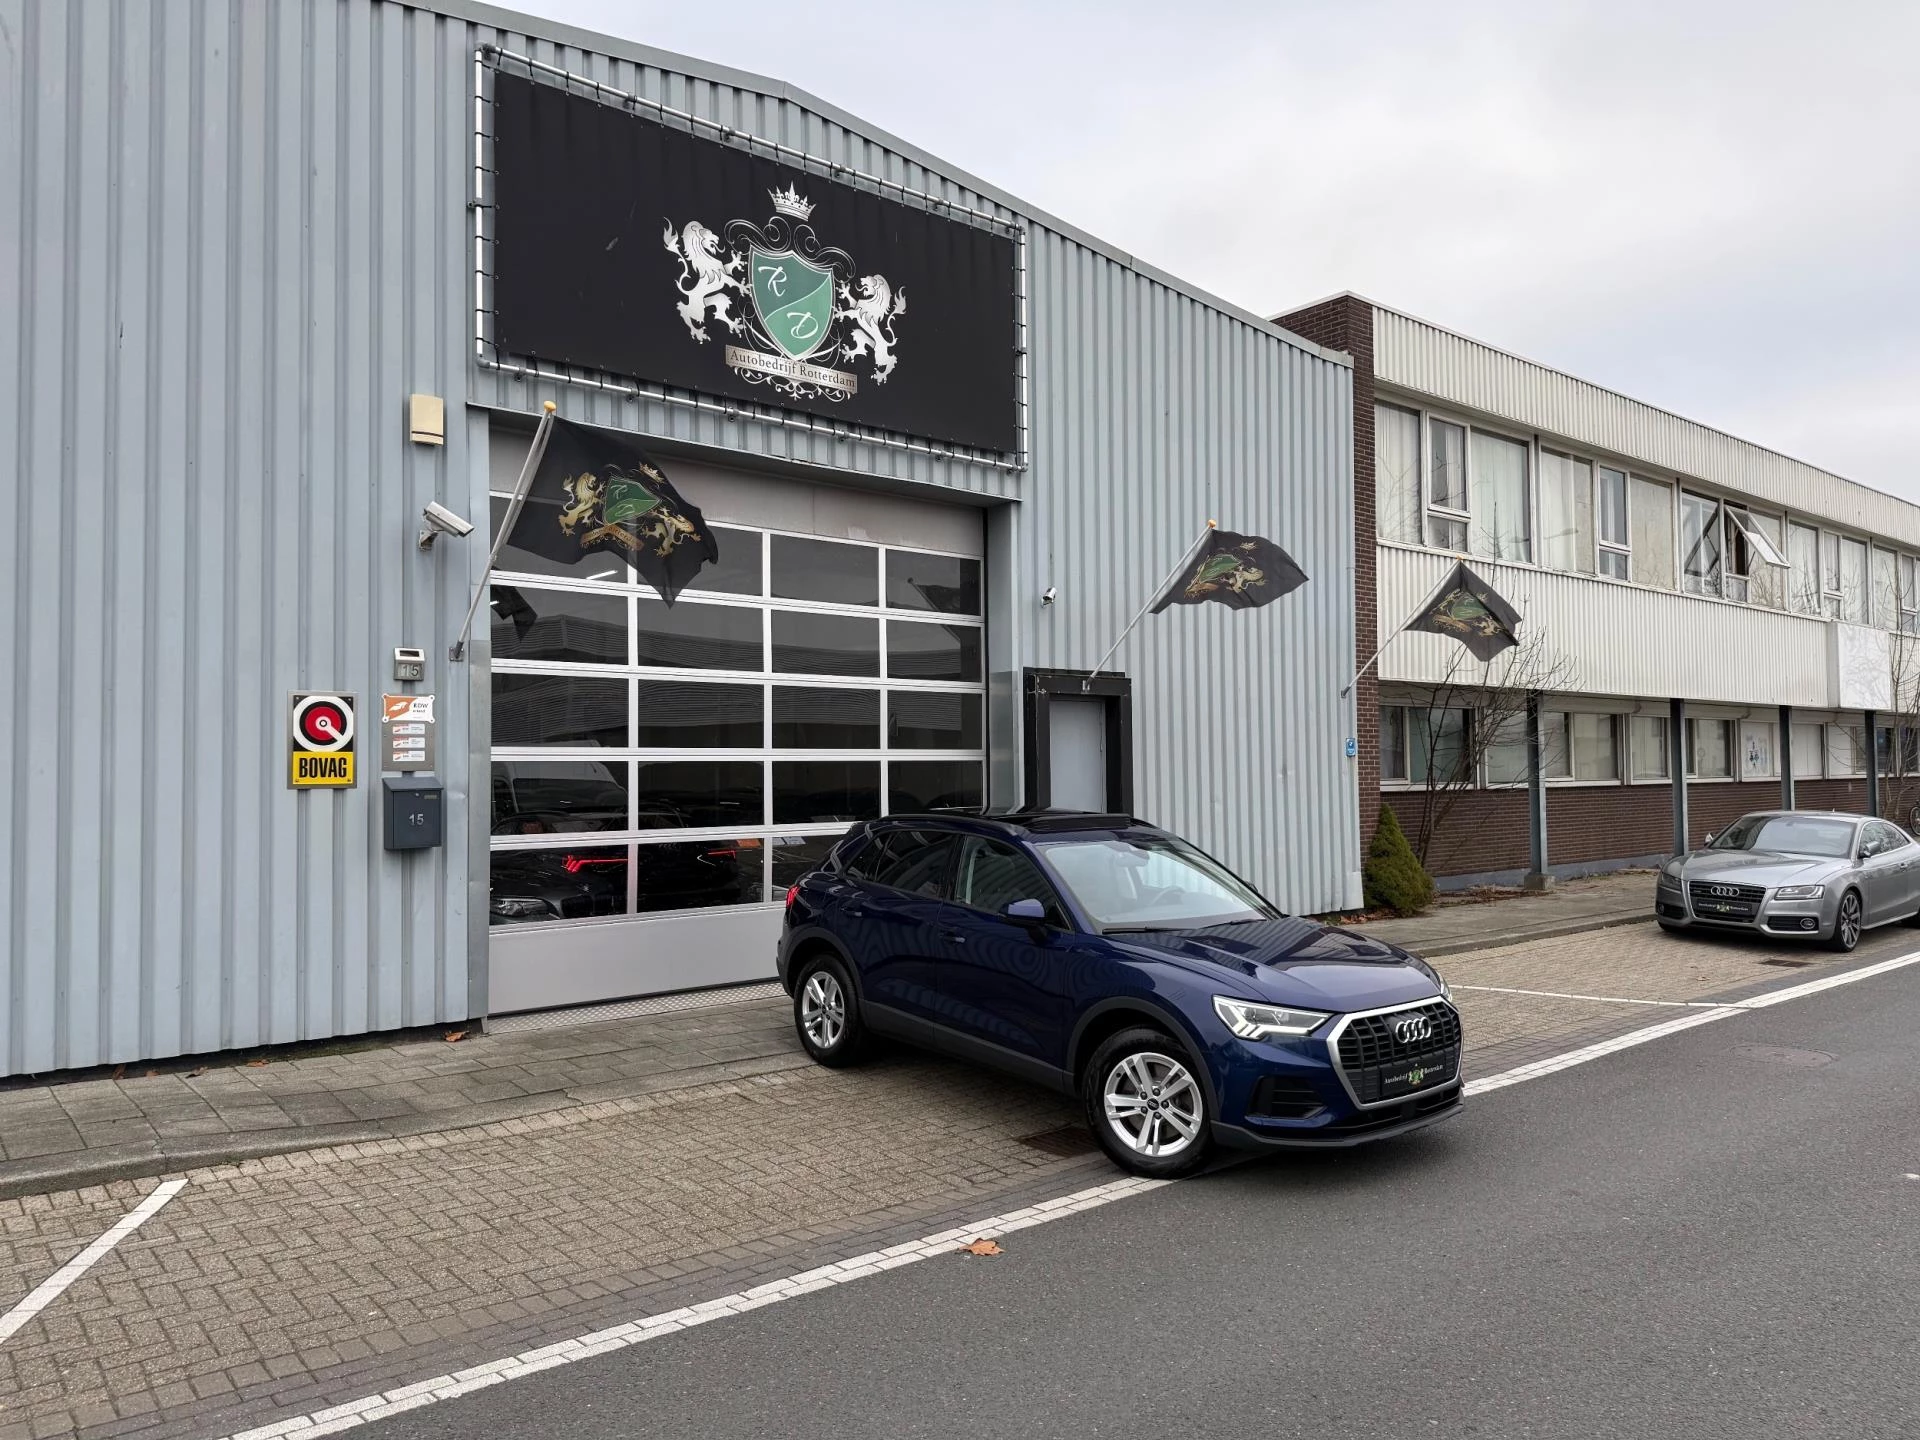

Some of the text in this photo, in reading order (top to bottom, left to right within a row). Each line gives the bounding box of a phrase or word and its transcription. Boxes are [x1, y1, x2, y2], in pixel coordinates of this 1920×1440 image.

[758, 266, 788, 297] R
[786, 312, 819, 339] D
[730, 350, 855, 387] Autobedrijf Rotterdam
[402, 664, 419, 677] 15
[298, 757, 348, 779] BOVAG
[408, 813, 425, 826] 15
